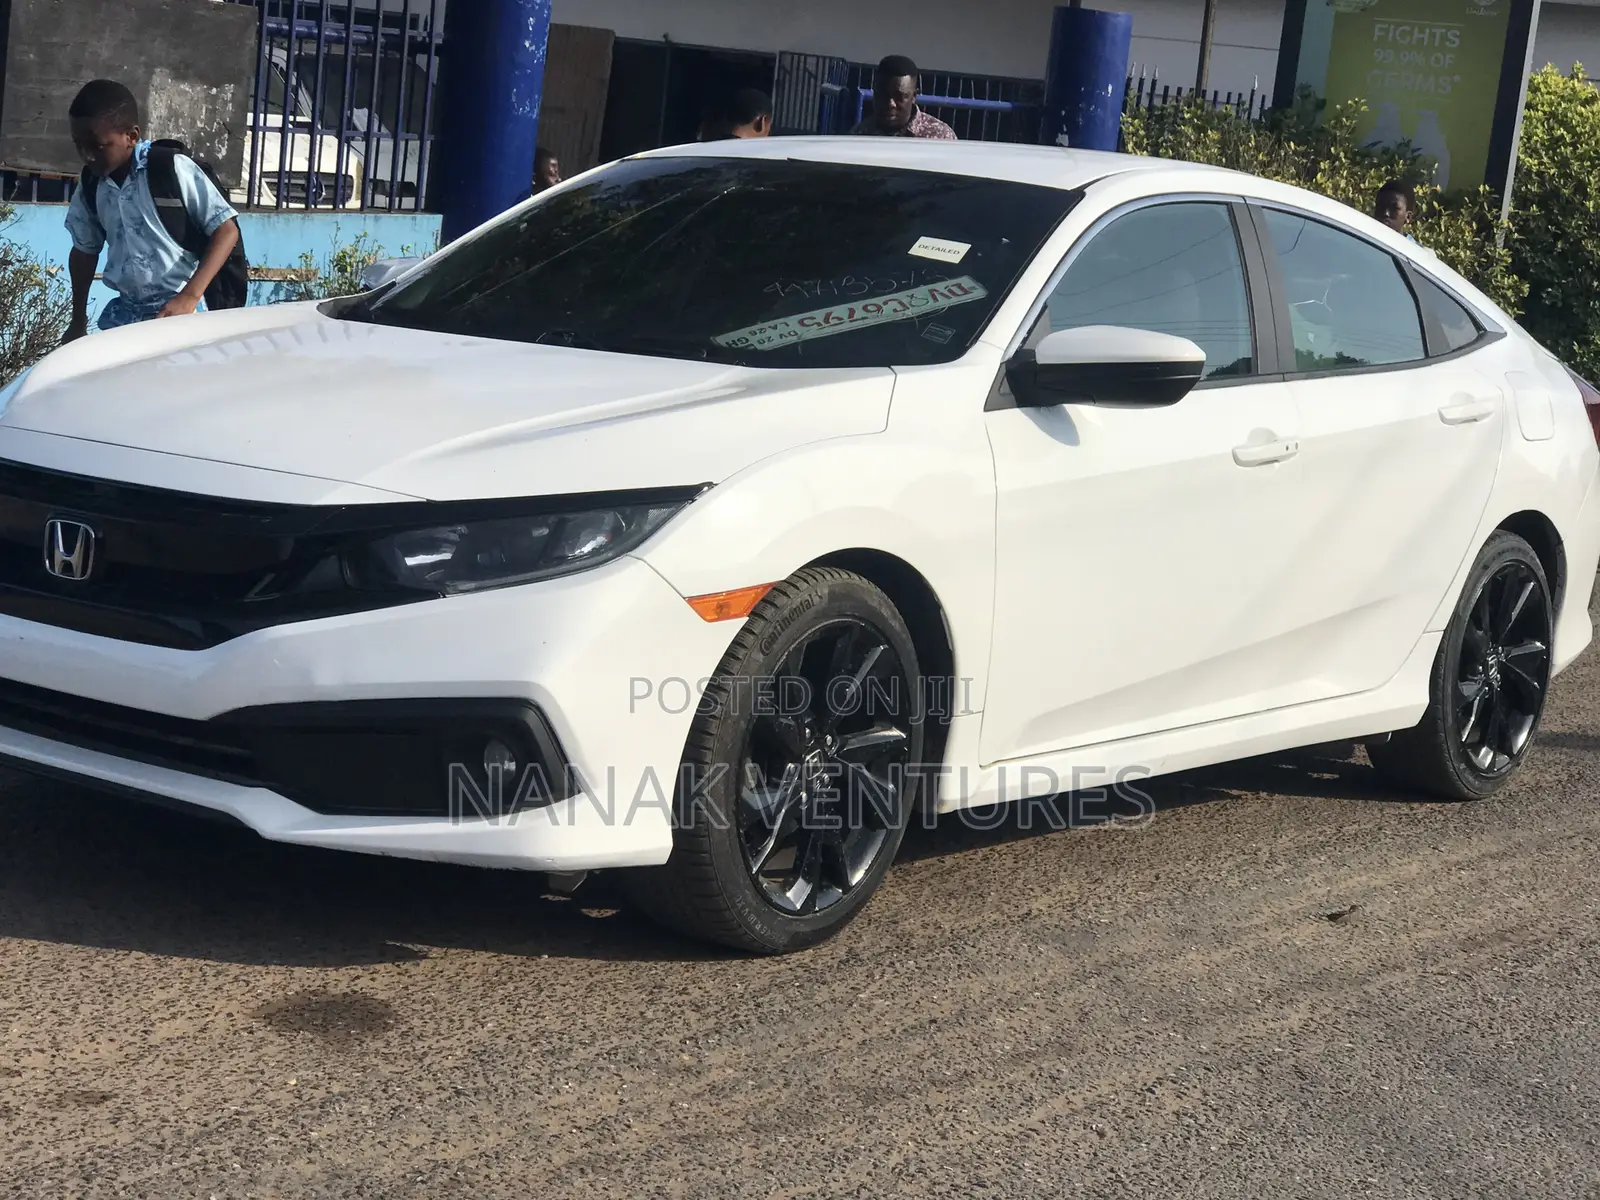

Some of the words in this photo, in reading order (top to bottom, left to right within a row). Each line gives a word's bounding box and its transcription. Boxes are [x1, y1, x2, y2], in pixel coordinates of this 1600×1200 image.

[1373, 24, 1461, 48] FIGHTS
[1374, 48, 1425, 68] 99.9%
[1430, 52, 1455, 69] OF
[917, 243, 961, 256] DETAILED
[760, 593, 816, 657] Continental
